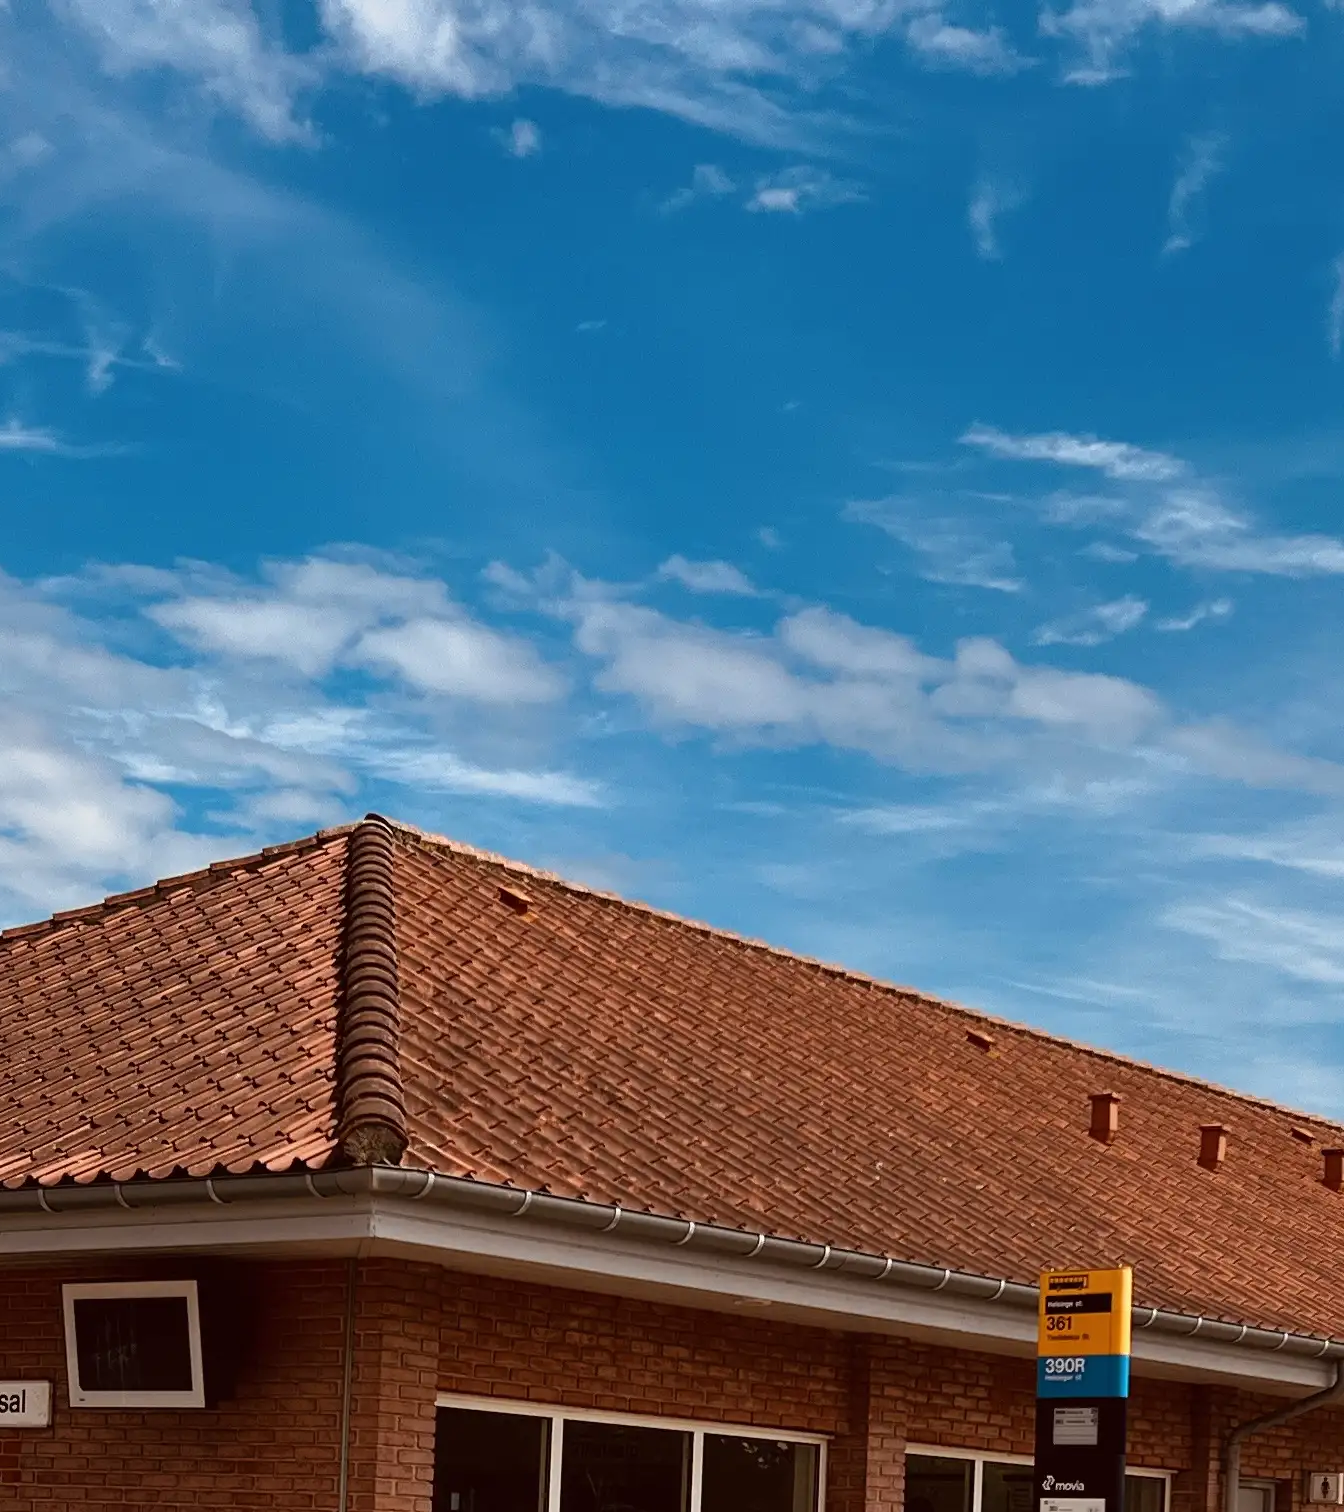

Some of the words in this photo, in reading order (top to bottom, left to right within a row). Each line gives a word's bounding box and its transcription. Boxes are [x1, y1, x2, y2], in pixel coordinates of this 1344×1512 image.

[1046, 1315, 1072, 1331] 361
[1045, 1357, 1085, 1374] 390R
[1055, 1480, 1085, 1491] movia
